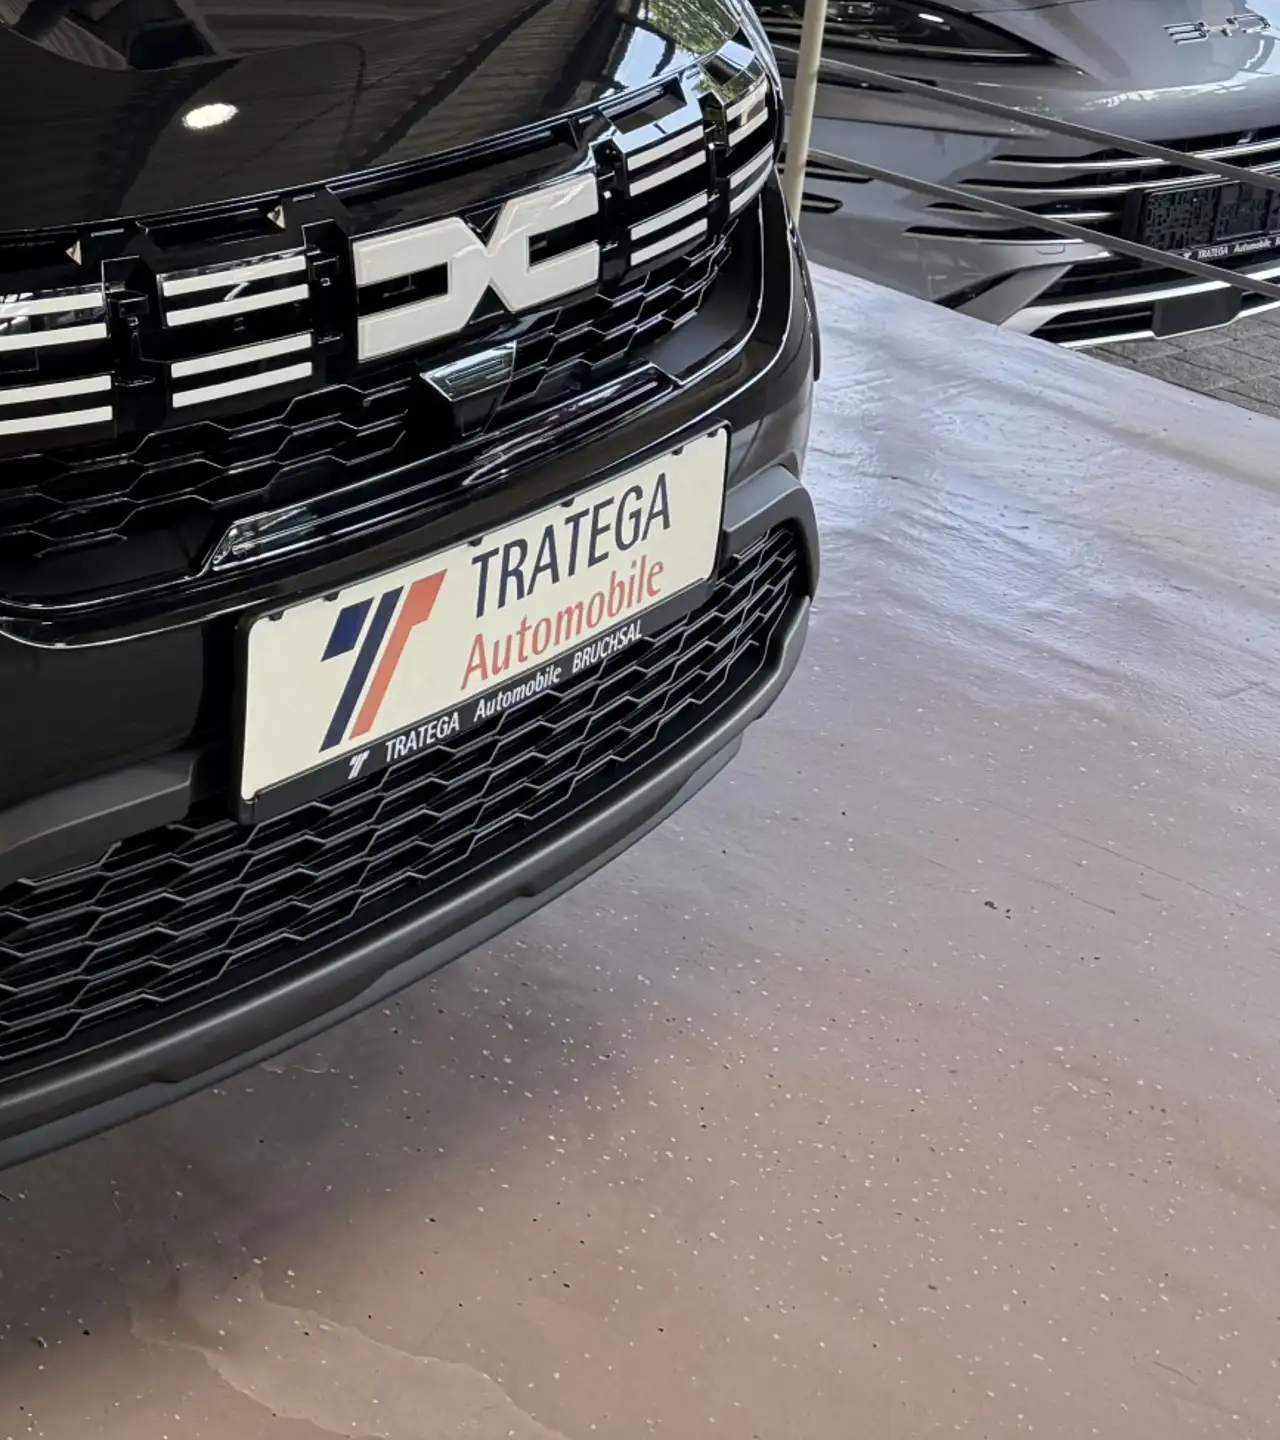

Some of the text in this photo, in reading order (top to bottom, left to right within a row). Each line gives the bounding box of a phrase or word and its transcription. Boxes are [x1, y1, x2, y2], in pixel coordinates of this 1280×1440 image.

[471, 472, 671, 619] TRATEGA
[385, 620, 643, 763] TRATEGA Automobile BRUCHSAL
[460, 554, 665, 692] Automobile
